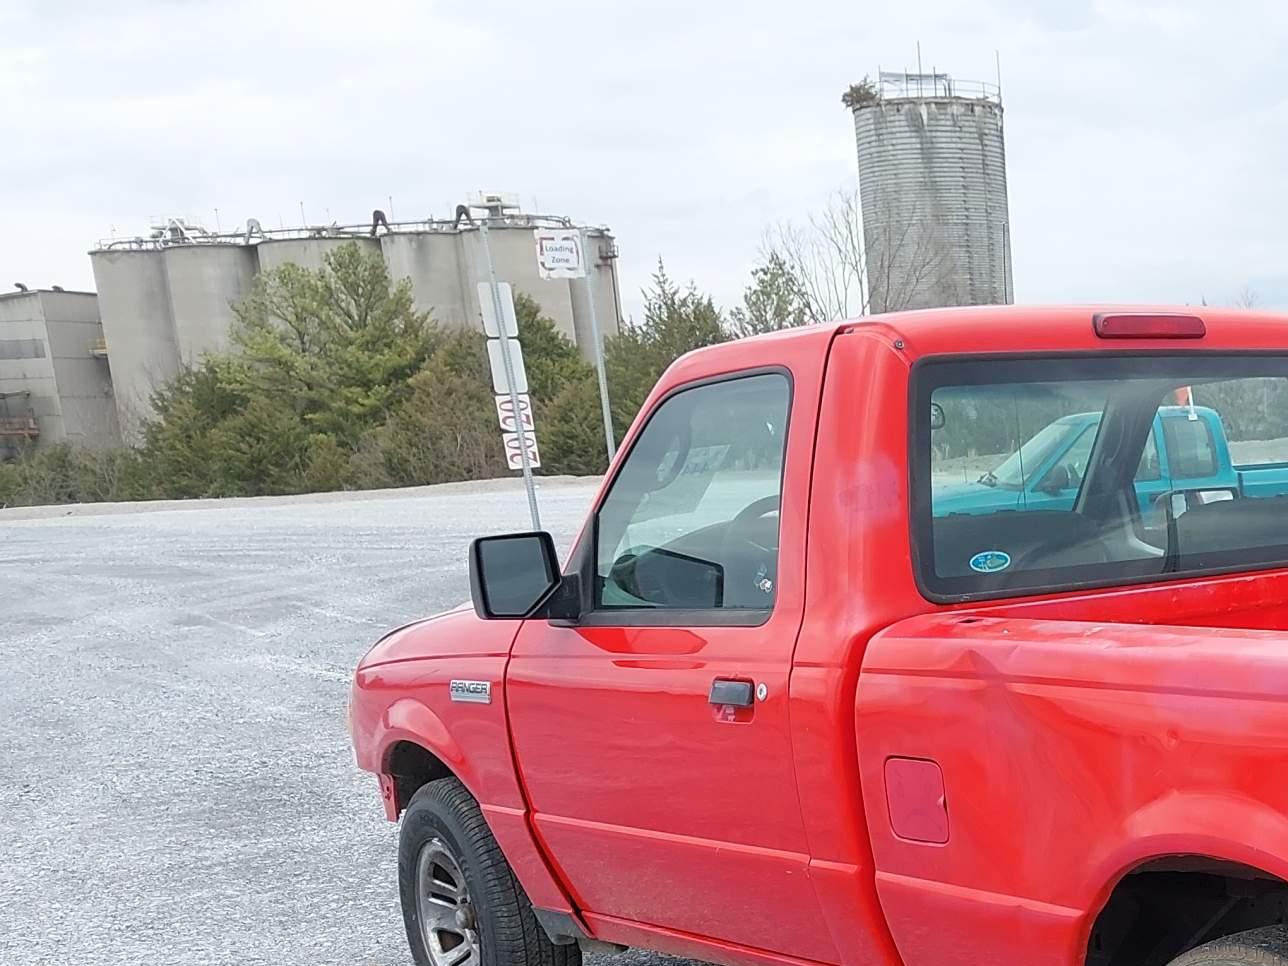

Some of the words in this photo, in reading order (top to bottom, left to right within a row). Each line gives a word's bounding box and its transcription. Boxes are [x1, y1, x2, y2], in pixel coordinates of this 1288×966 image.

[545, 245, 574, 254] Loading
[551, 256, 570, 264] Zone
[451, 681, 488, 694] RANGER
